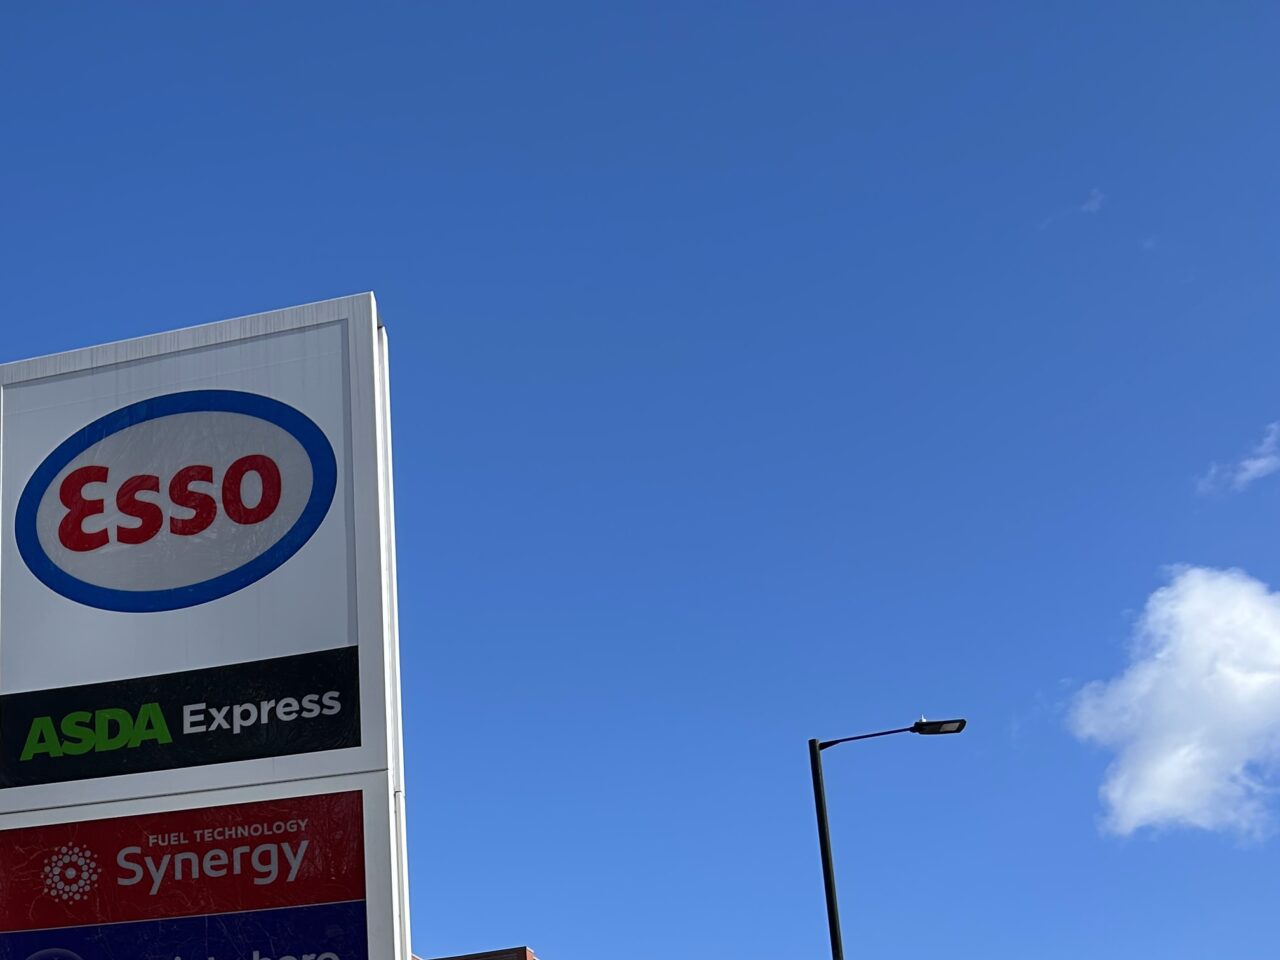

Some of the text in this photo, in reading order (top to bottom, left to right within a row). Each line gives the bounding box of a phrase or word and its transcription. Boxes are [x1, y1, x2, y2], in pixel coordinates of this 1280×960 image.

[58, 454, 282, 552] Esso
[20, 690, 342, 761] ASDA Express
[148, 818, 309, 847] FUEL TECHNOLOGY
[117, 839, 309, 895] Synergy
